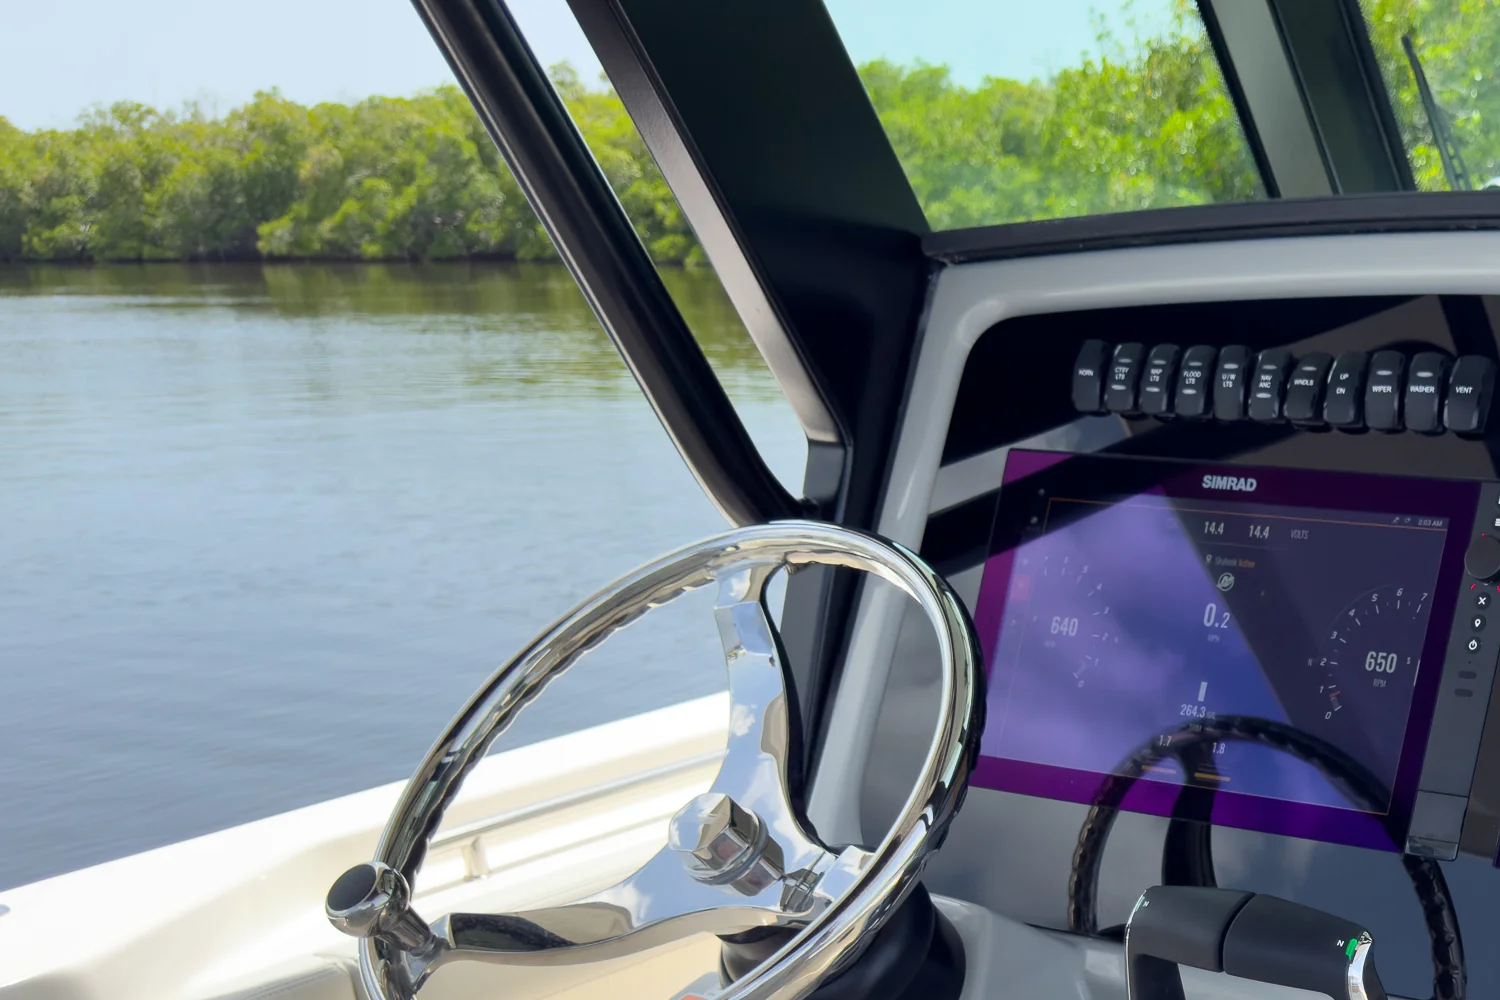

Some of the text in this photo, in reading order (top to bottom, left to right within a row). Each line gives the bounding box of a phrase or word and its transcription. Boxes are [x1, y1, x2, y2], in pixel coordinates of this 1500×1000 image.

[1184, 370, 1202, 378] FLOOD
[1185, 377, 1195, 385] LTS
[1223, 380, 1233, 388] LTS
[1409, 385, 1435, 394] WASHER
[1455, 386, 1473, 394] VENT
[1202, 475, 1257, 492] SIMRAD
[1417, 518, 1431, 526] 2:03
[1204, 521, 1309, 540] 14.4 14.4 VOLTS
[1396, 588, 1403, 596] 6
[1372, 594, 1378, 602] 5
[1421, 593, 1428, 601] 7
[1203, 603, 1231, 629] 0.2
[1348, 608, 1356, 617] 4
[1051, 616, 1079, 637] 640
[1330, 631, 1338, 639] 3
[1320, 658, 1327, 666] 2
[1365, 651, 1397, 673] 650
[1373, 679, 1386, 688] RPM
[1180, 703, 1206, 718] 264.3
[1325, 711, 1331, 719] 0
[1160, 735, 1172, 747] 1.7
[1212, 742, 1226, 754] 1.8
[1336, 939, 1344, 947] N
